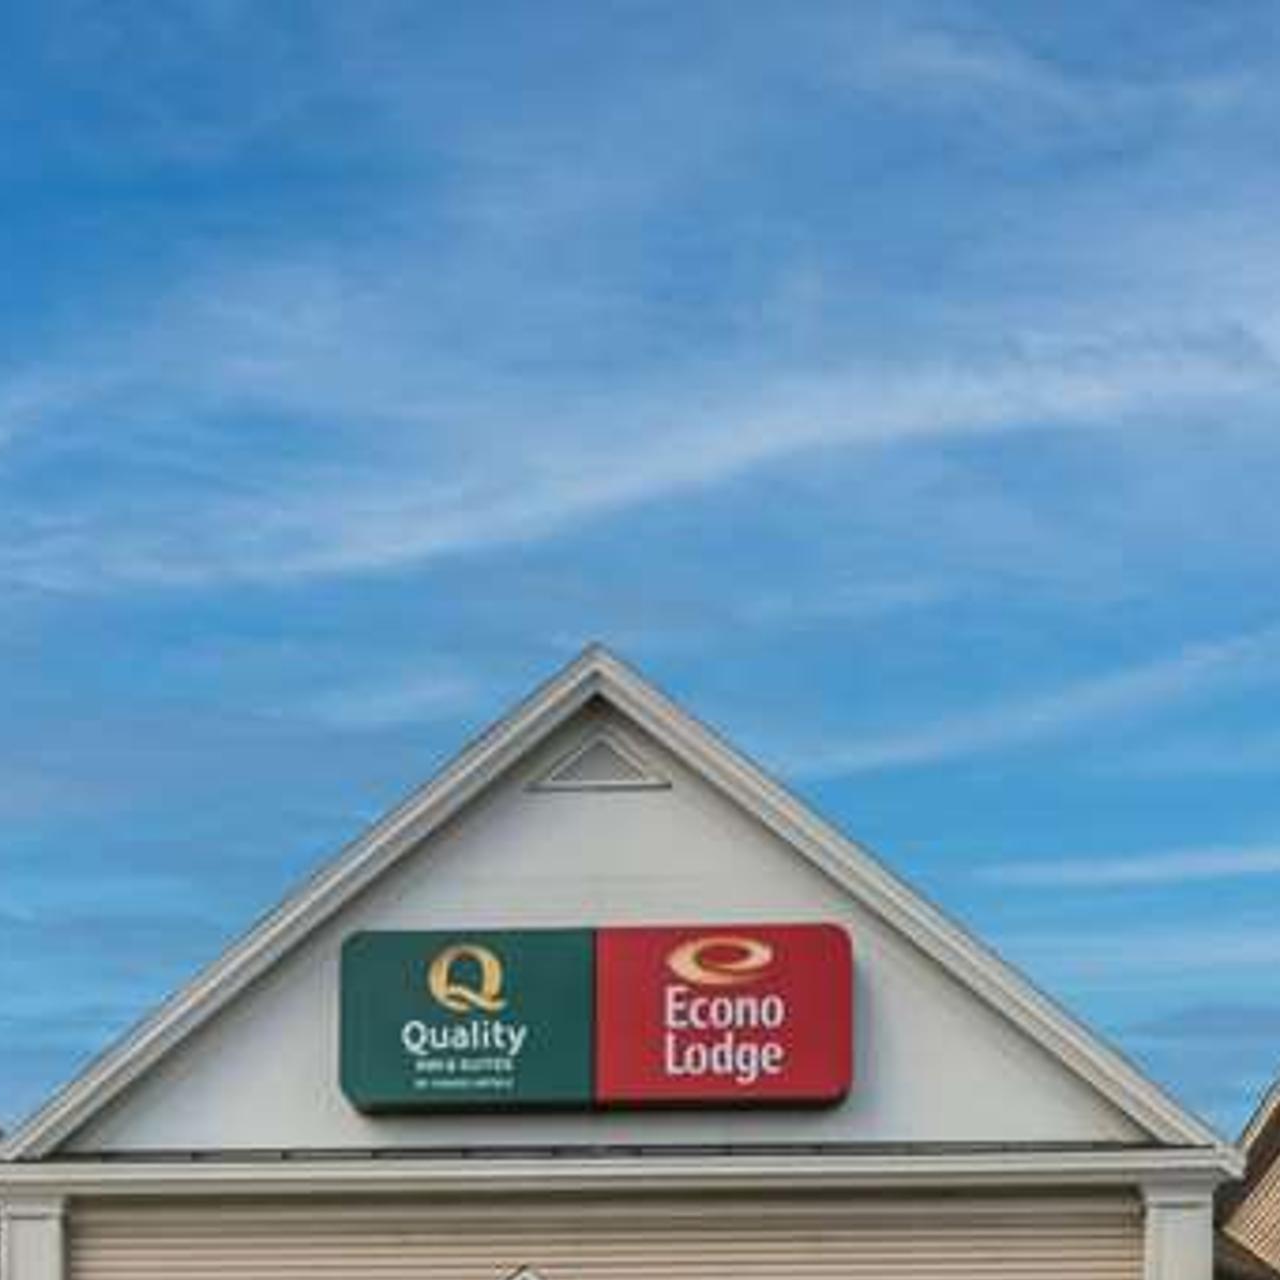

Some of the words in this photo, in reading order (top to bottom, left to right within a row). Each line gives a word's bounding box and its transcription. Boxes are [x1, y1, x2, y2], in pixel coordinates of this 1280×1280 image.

[428, 945, 508, 1011] Q
[665, 984, 785, 1029] Econo
[401, 1019, 527, 1056] Quality
[665, 1030, 785, 1085] Lodge
